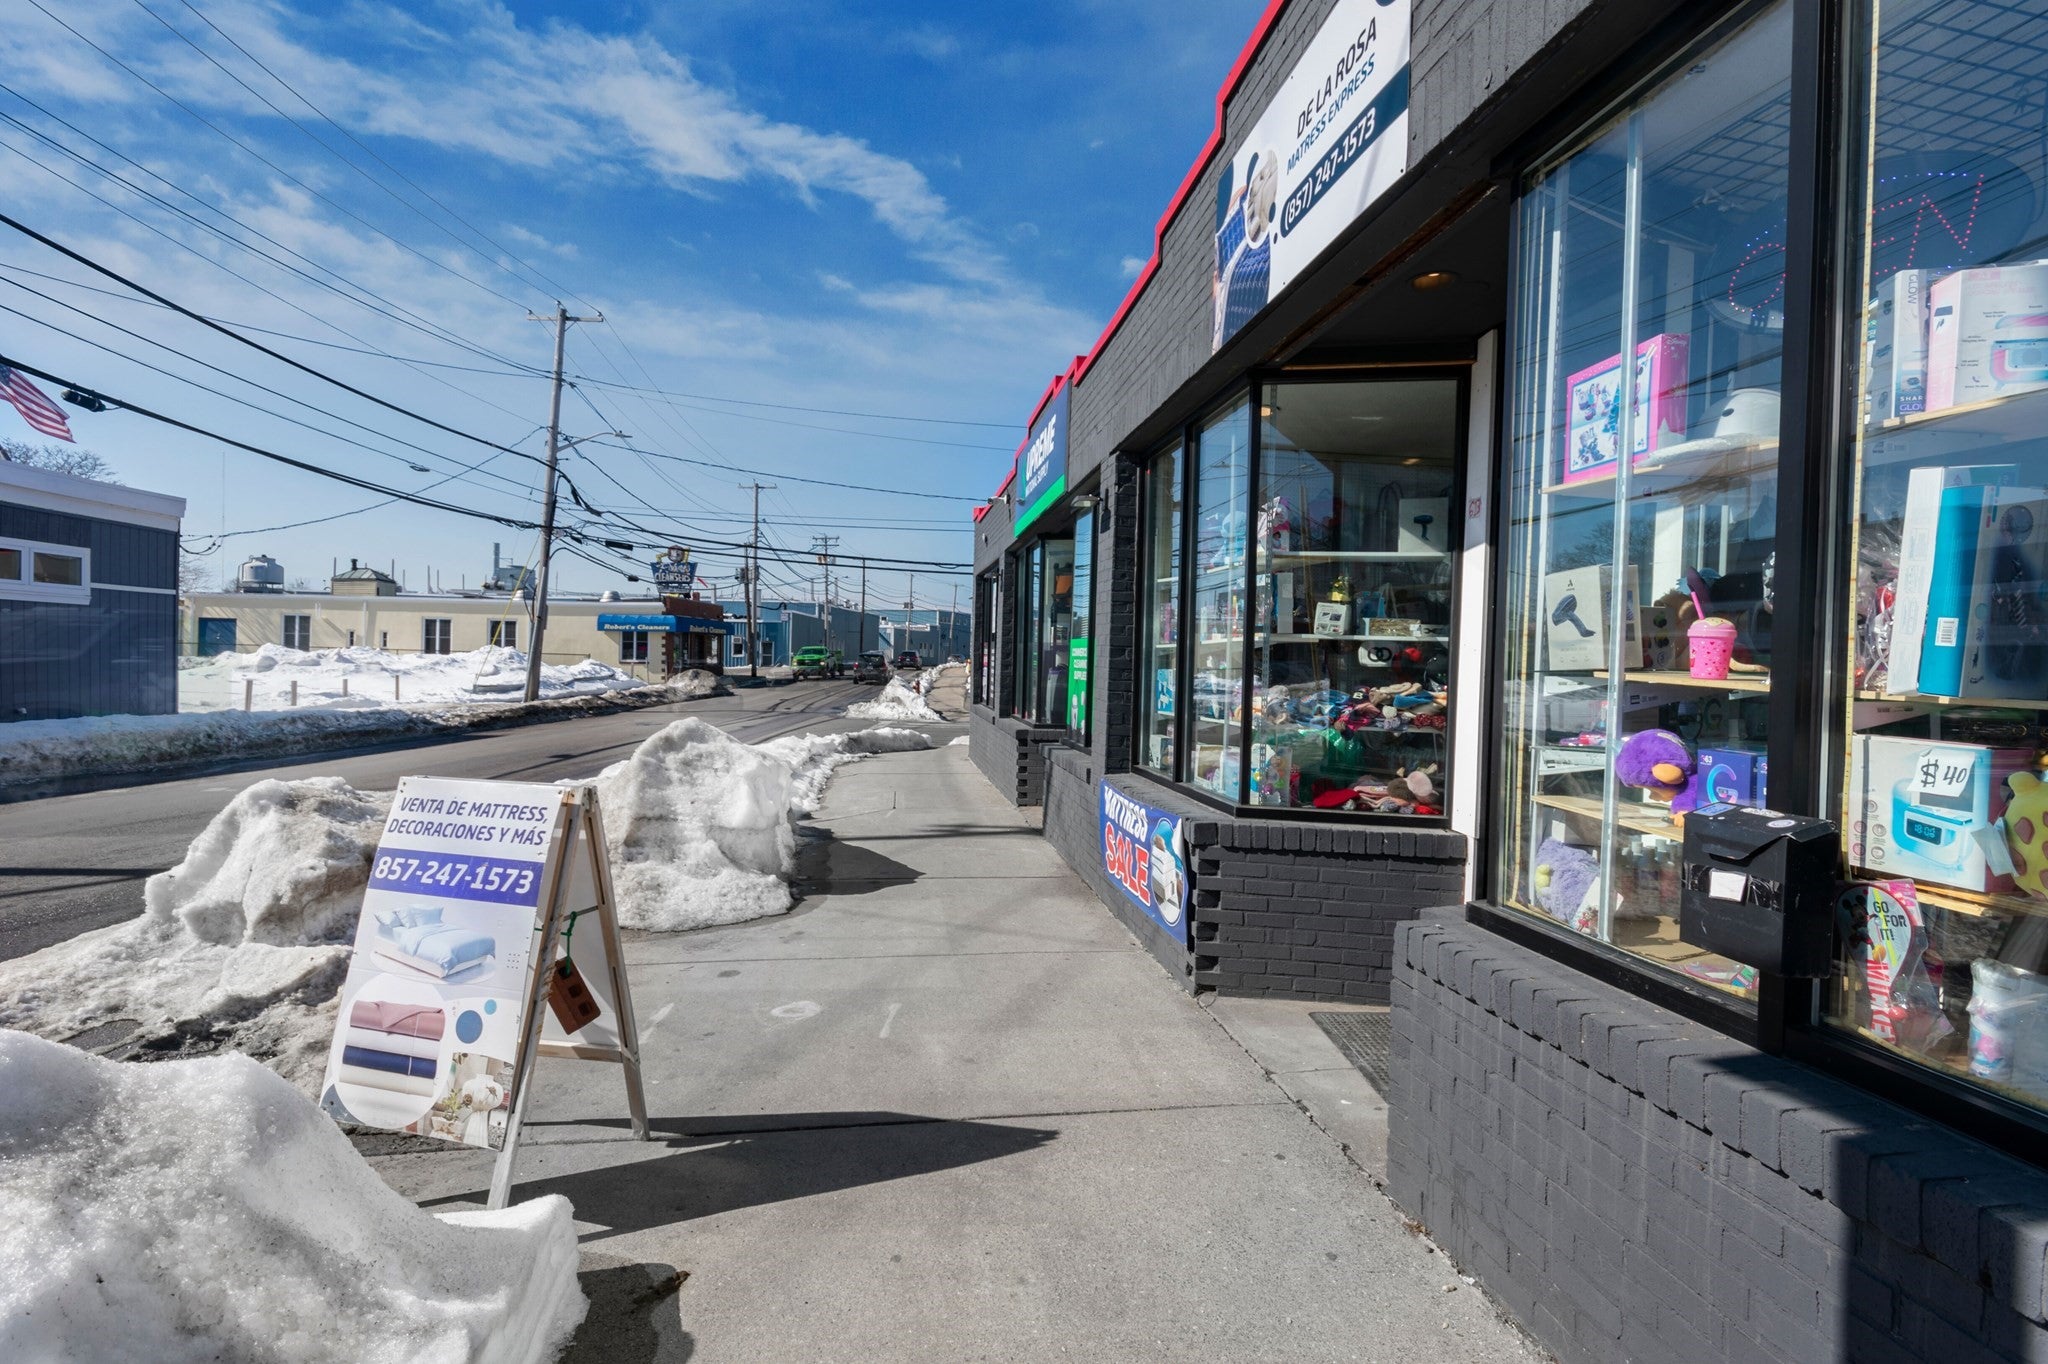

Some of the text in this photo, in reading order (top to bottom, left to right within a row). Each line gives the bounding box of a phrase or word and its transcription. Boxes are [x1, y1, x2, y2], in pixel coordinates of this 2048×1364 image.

[1297, 16, 1377, 139] DE LA ROSA
[1287, 54, 1375, 175] MATRESS EXPRESS
[1284, 107, 1376, 230] (857) 247-1573
[1907, 274, 1918, 304] GLOW
[1921, 759, 1968, 788] $ 40
[400, 797, 549, 823] VENTA DE MATTRESS,
[1104, 785, 1148, 842] MATTRESS
[388, 818, 546, 846] DECORACIONES Y MÁS
[374, 856, 535, 895] 857-247-1573
[1105, 821, 1150, 907] SALE
[1873, 901, 1889, 913] GO
[1883, 914, 1907, 928] FOR
[1879, 928, 1895, 941] IT!
